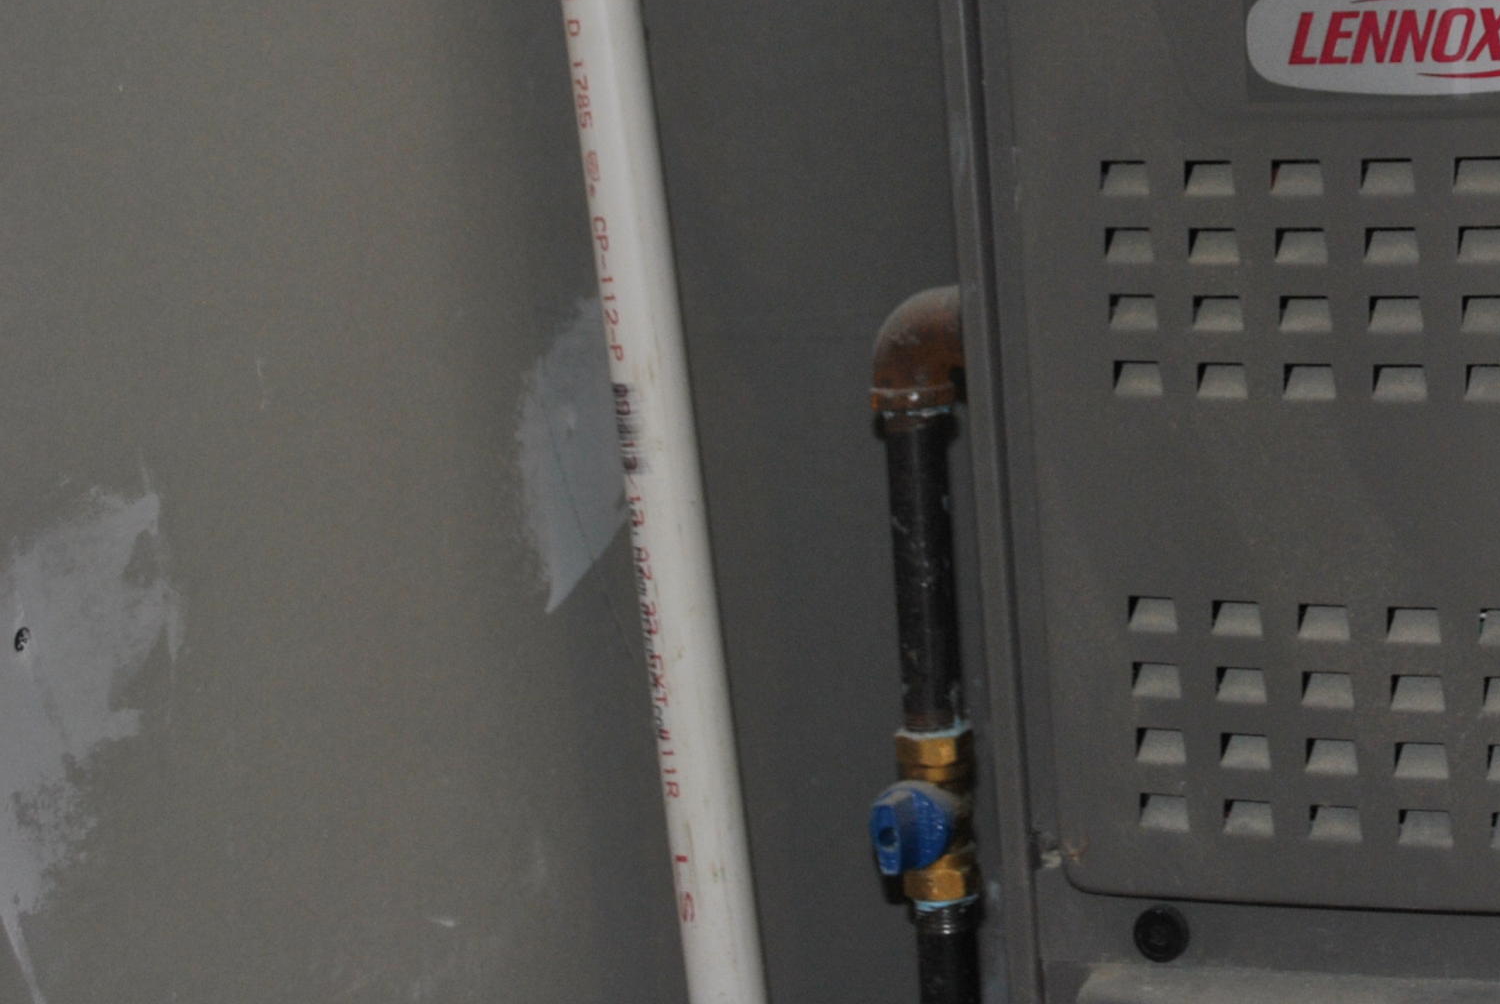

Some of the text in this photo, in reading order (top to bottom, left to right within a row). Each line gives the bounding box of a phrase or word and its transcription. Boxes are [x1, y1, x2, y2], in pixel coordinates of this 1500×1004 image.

[566, 19, 581, 37] D
[573, 62, 594, 129] 1785
[593, 216, 624, 362] CP-112-P
